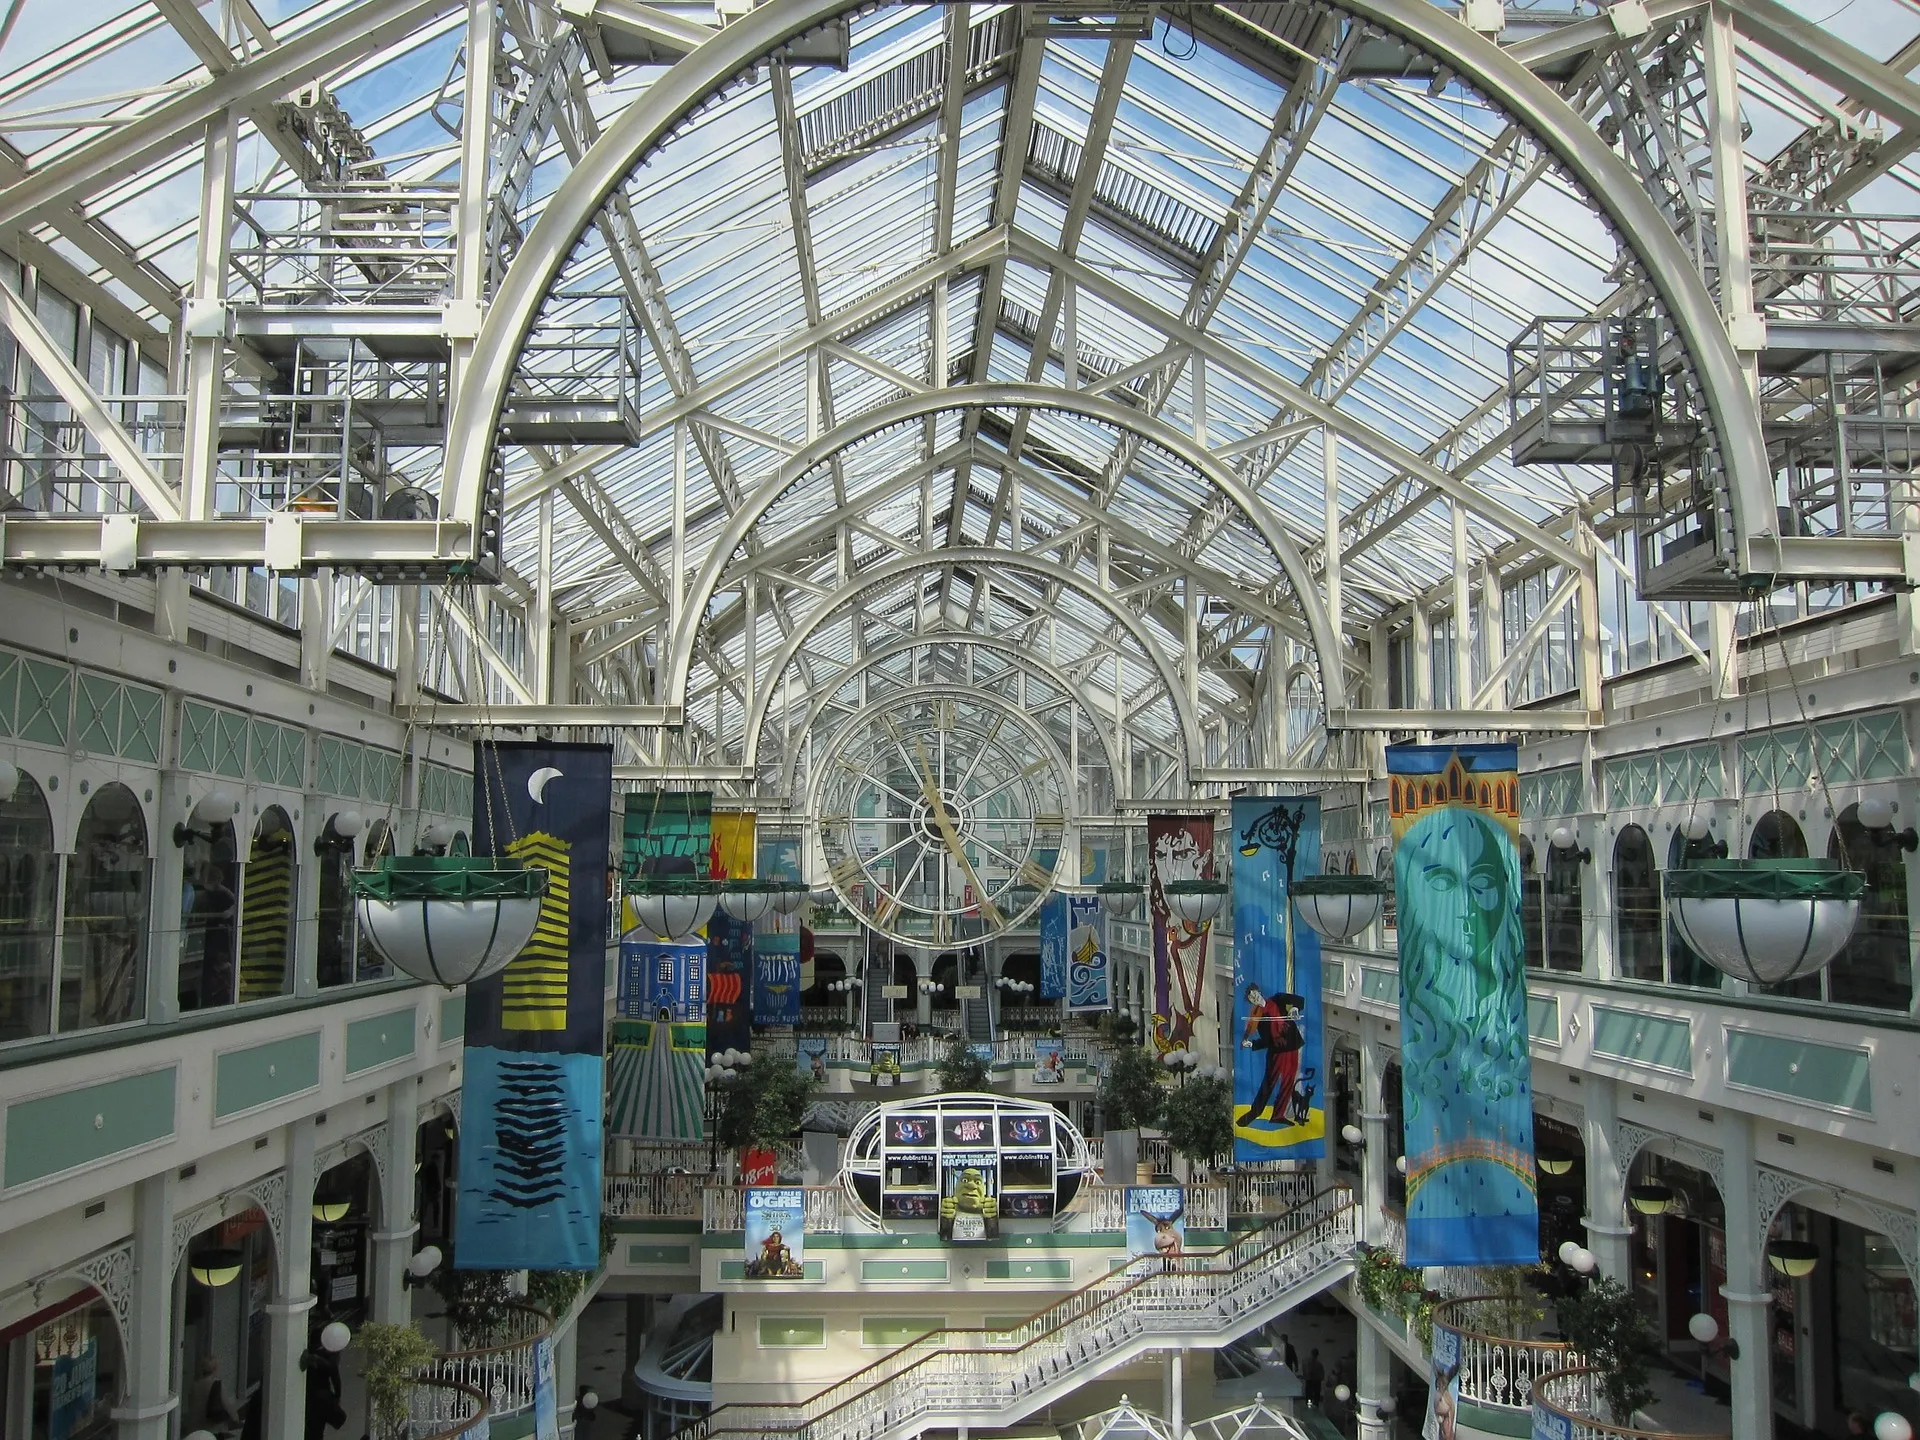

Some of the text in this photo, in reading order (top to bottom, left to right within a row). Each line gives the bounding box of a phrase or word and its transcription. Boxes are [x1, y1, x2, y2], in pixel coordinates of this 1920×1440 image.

[962, 1132, 981, 1141] MIX
[942, 1158, 997, 1167] HAPPENED?
[1130, 1189, 1180, 1199] WAFFLES
[750, 1196, 802, 1208] OGRE
[1130, 1203, 1180, 1213] DANGER
